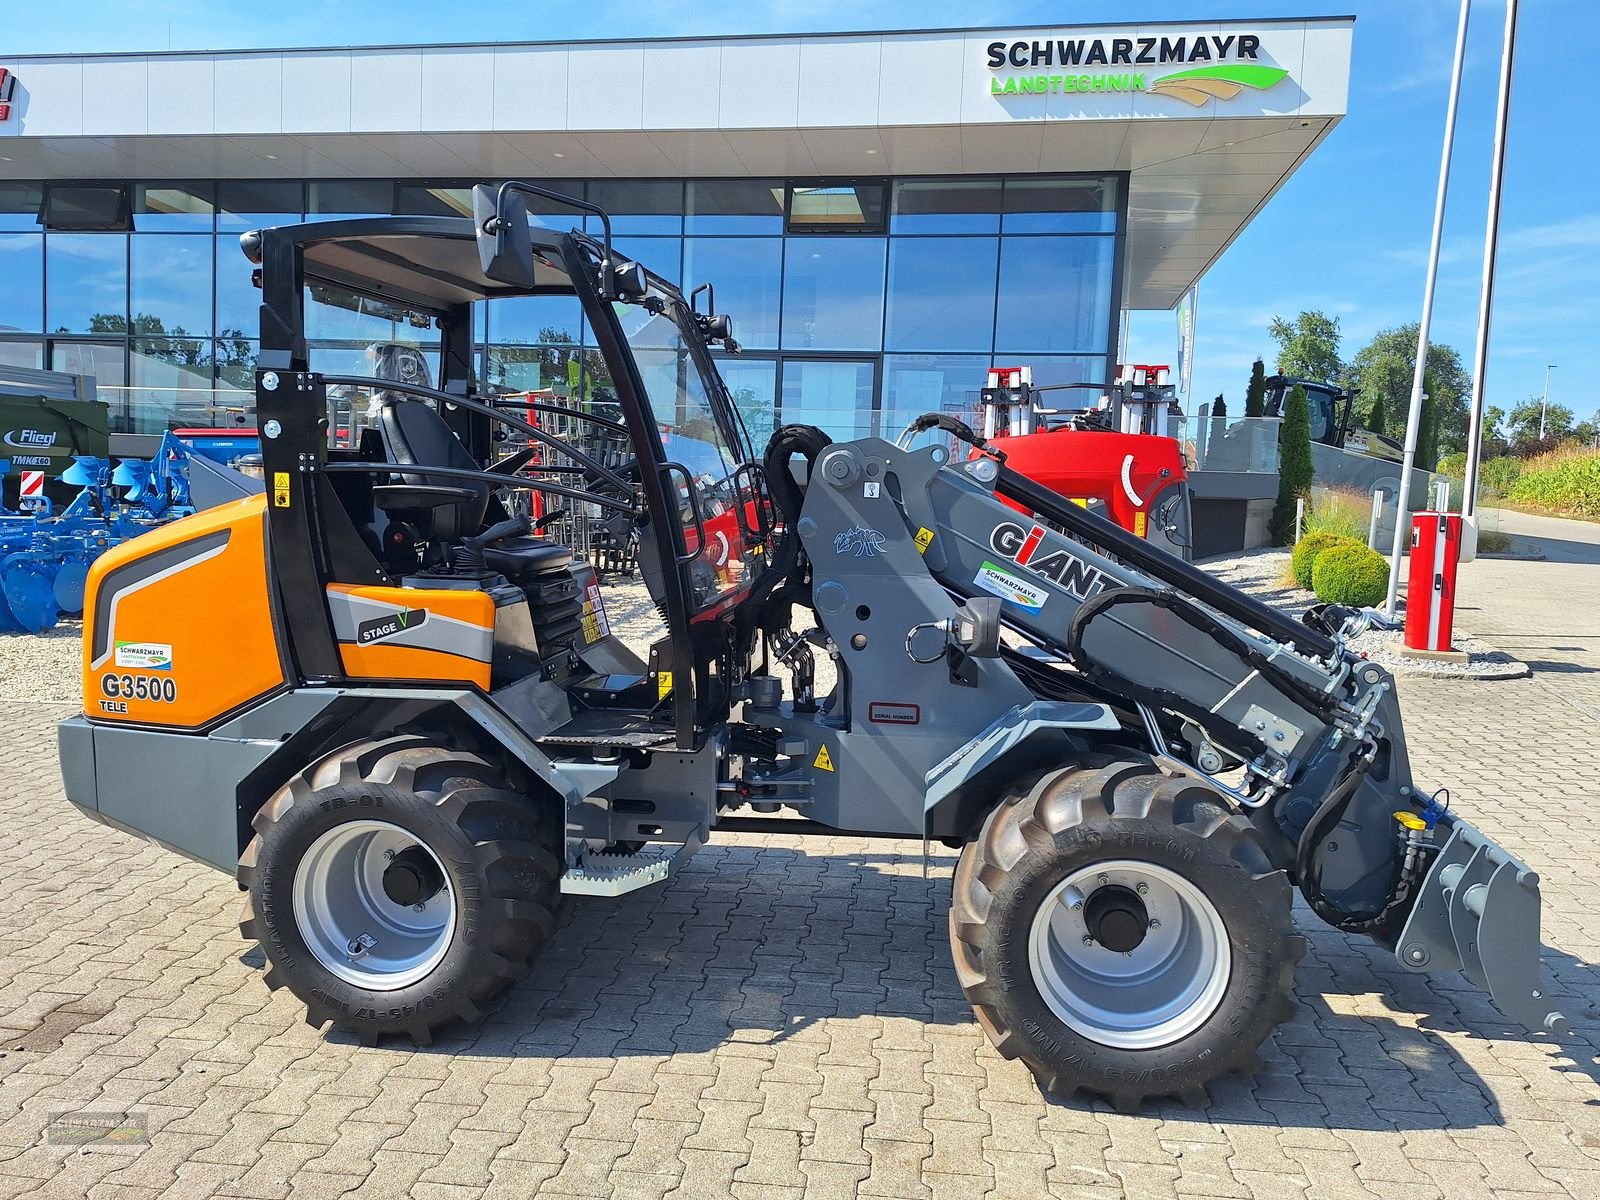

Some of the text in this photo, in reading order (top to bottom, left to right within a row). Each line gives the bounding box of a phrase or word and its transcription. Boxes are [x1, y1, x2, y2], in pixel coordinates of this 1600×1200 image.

[986, 34, 1261, 68] SCHWARZMAYR
[991, 72, 1147, 96] LANDTECHNIK
[20, 429, 57, 446] Fliegl
[985, 569, 1037, 599] SCHWARZMAYR
[363, 622, 398, 640] STAGE
[120, 647, 164, 656] SCHWARZMAYR
[102, 673, 177, 703] G3500
[99, 700, 128, 714] TELE
